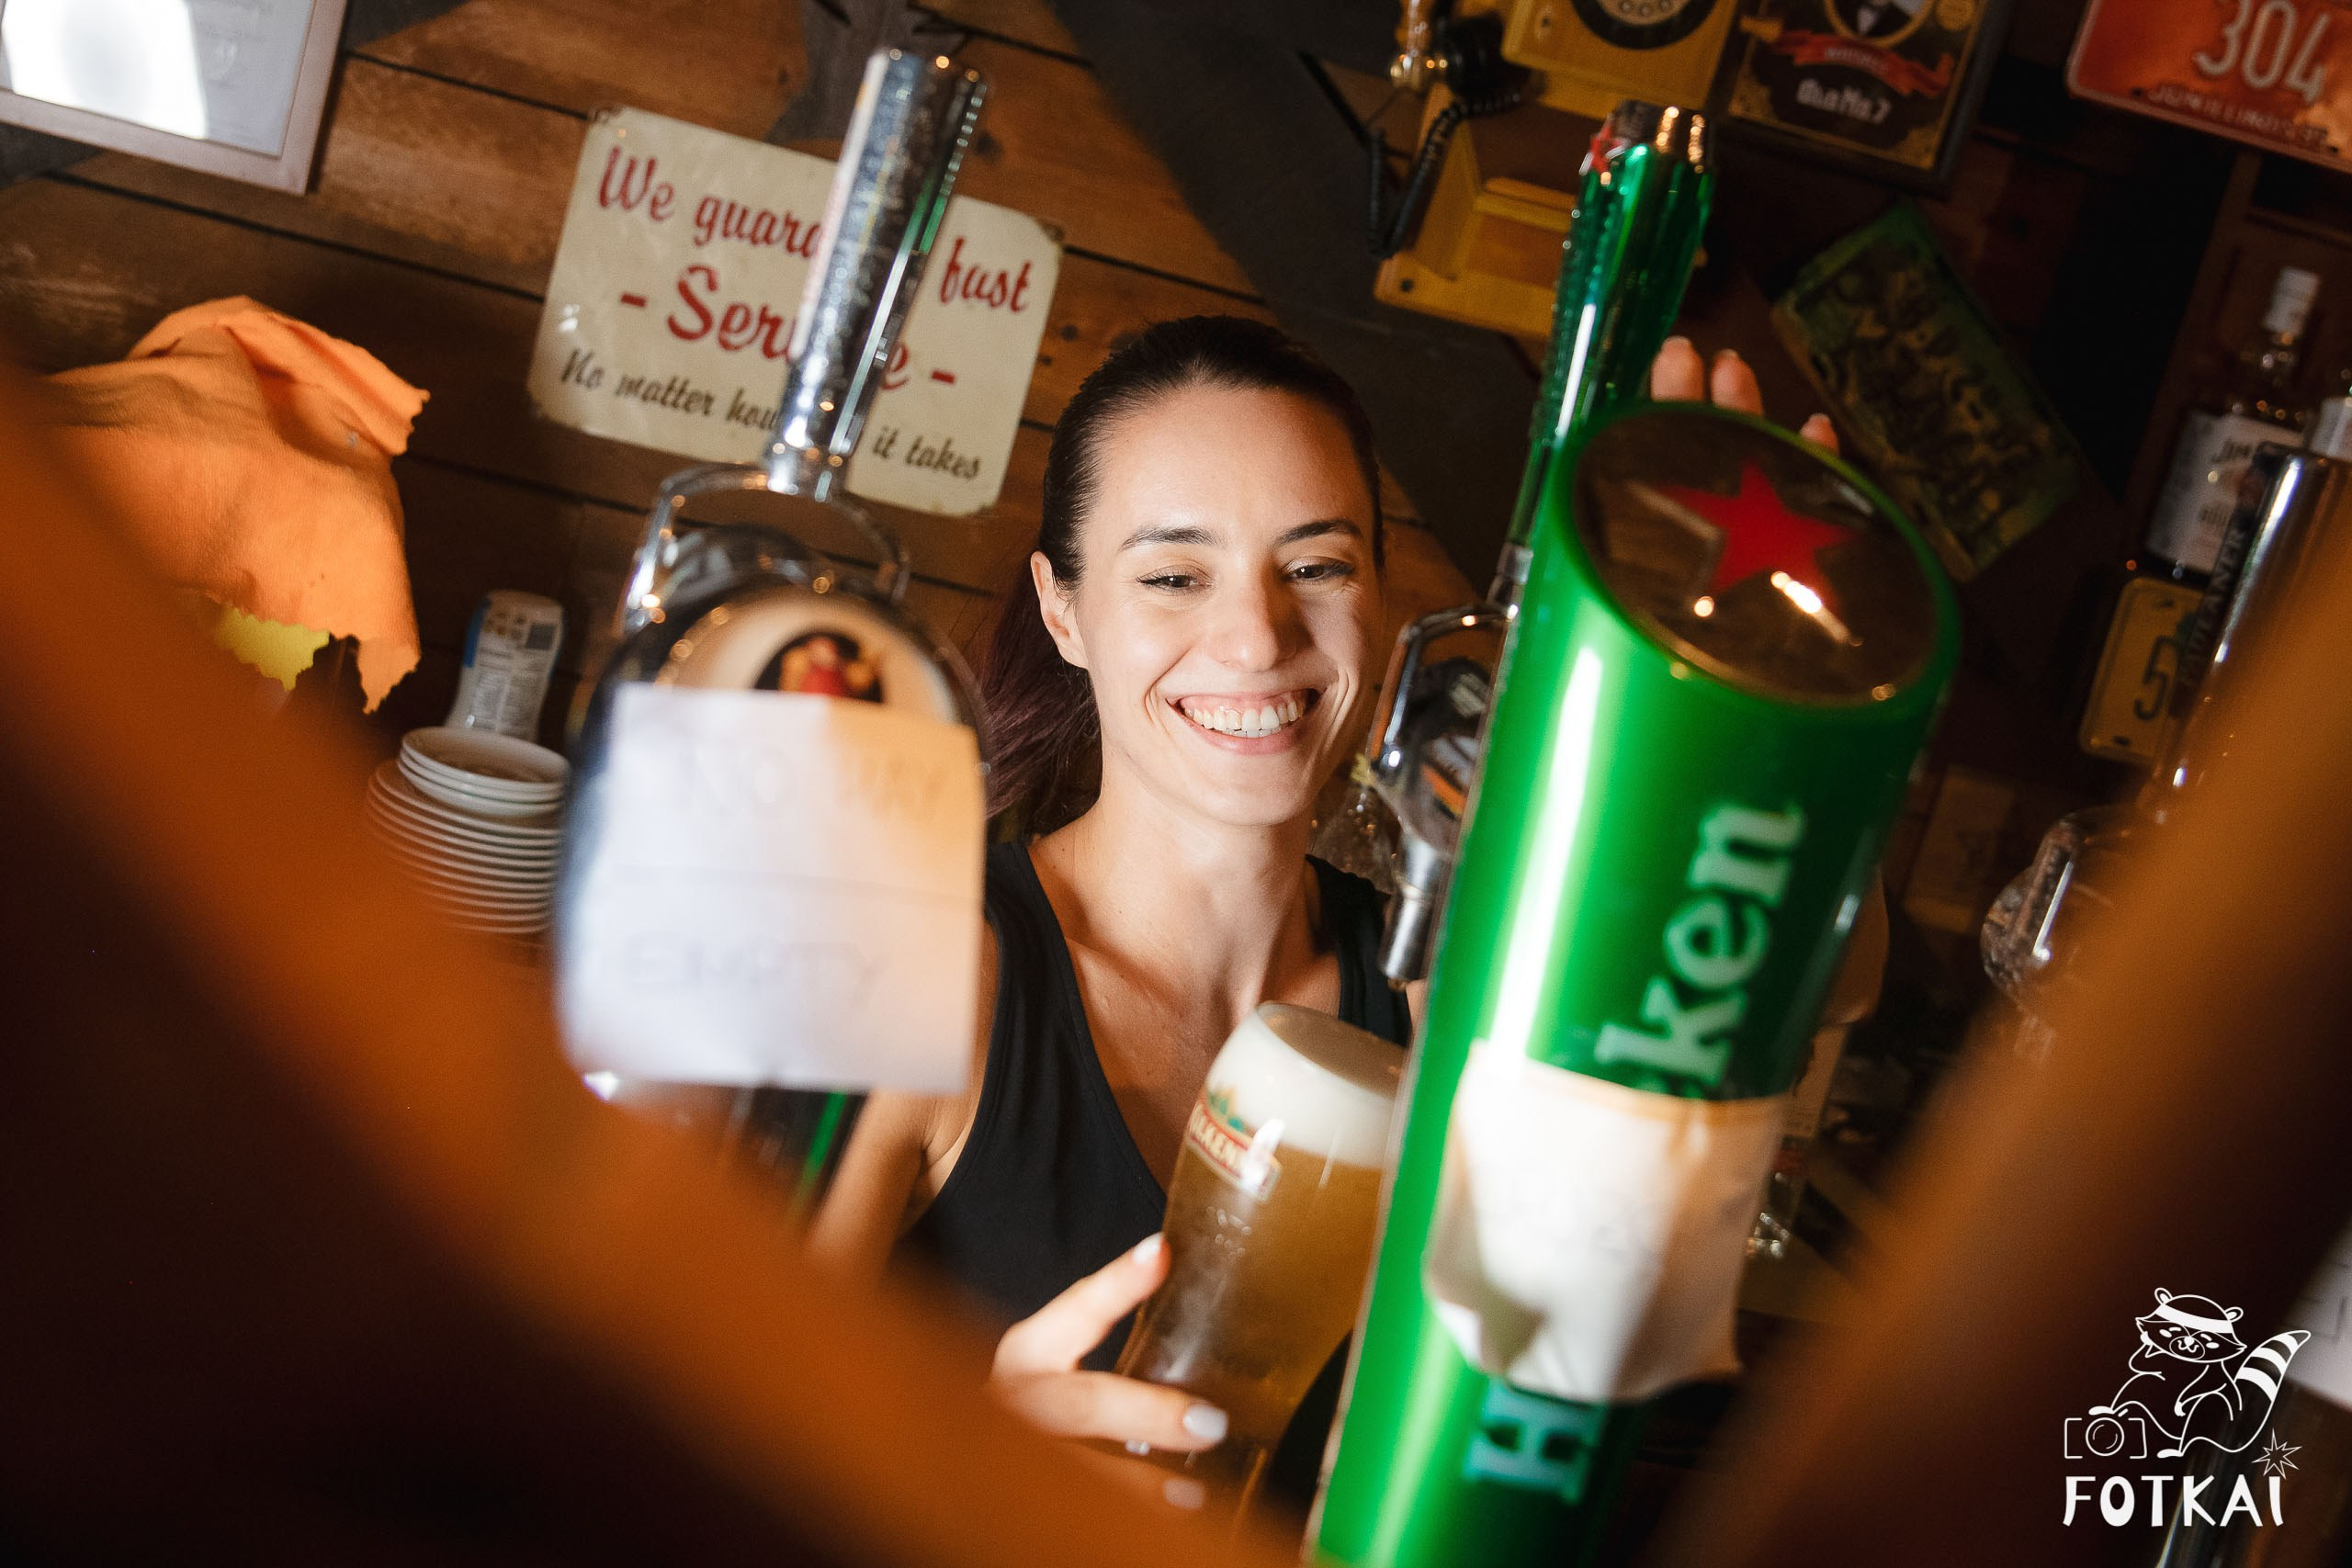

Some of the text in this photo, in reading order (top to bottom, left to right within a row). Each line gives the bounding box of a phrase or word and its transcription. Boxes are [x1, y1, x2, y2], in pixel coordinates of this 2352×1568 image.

[2194, 0, 2329, 103] 304
[598, 146, 1034, 313] We guara fast
[668, 264, 910, 390] Sere
[560, 347, 605, 389] No
[615, 374, 715, 416] matter
[873, 424, 898, 459] it
[905, 434, 981, 479] takes
[624, 930, 889, 1012] EMPTY
